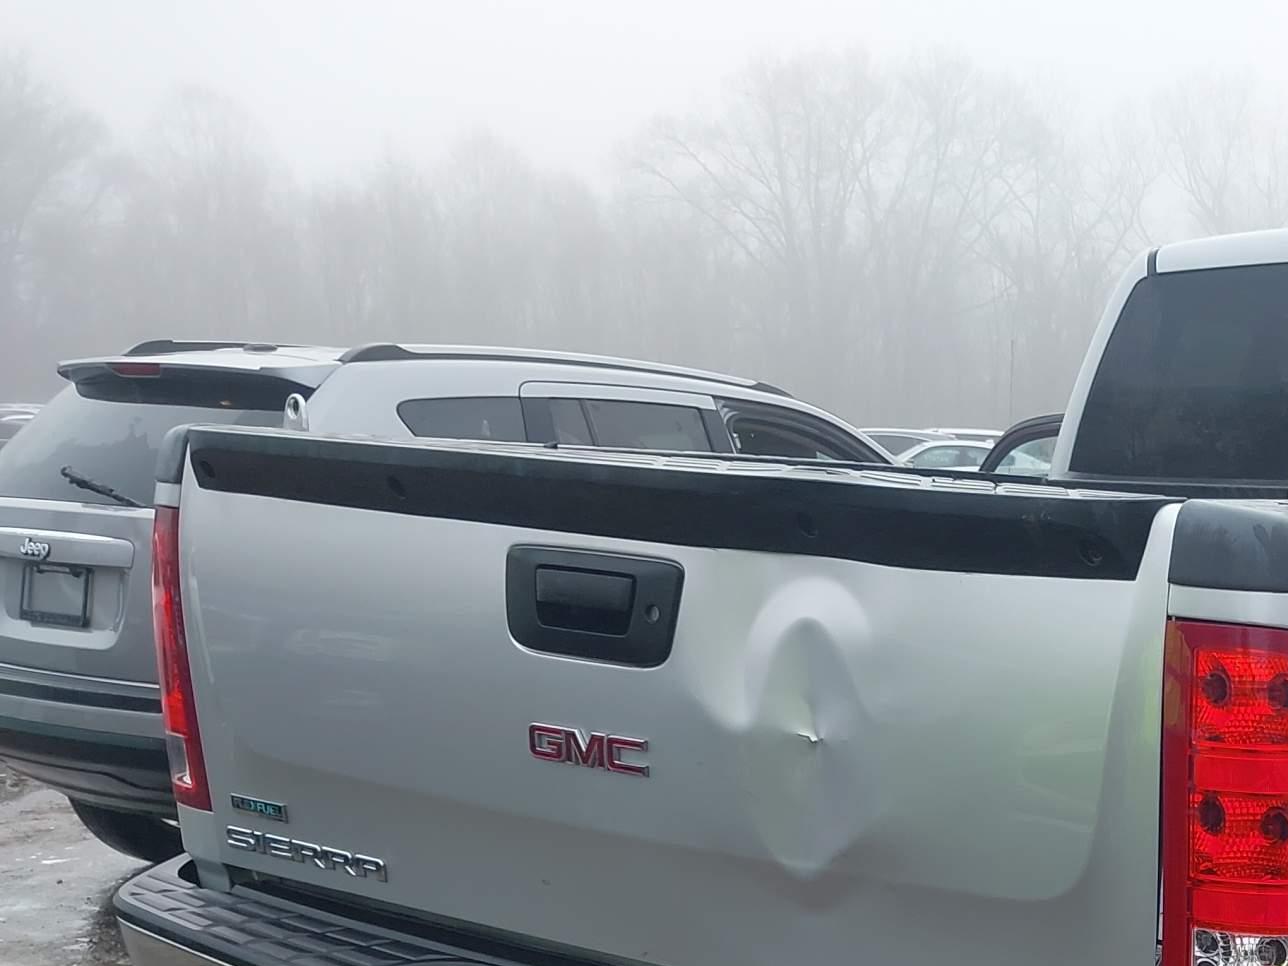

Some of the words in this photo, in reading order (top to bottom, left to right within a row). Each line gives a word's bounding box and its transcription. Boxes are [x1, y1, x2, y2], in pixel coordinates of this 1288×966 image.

[20, 537, 50, 560] Jeep
[528, 721, 650, 778] GMC
[226, 825, 389, 884] SIERRA
